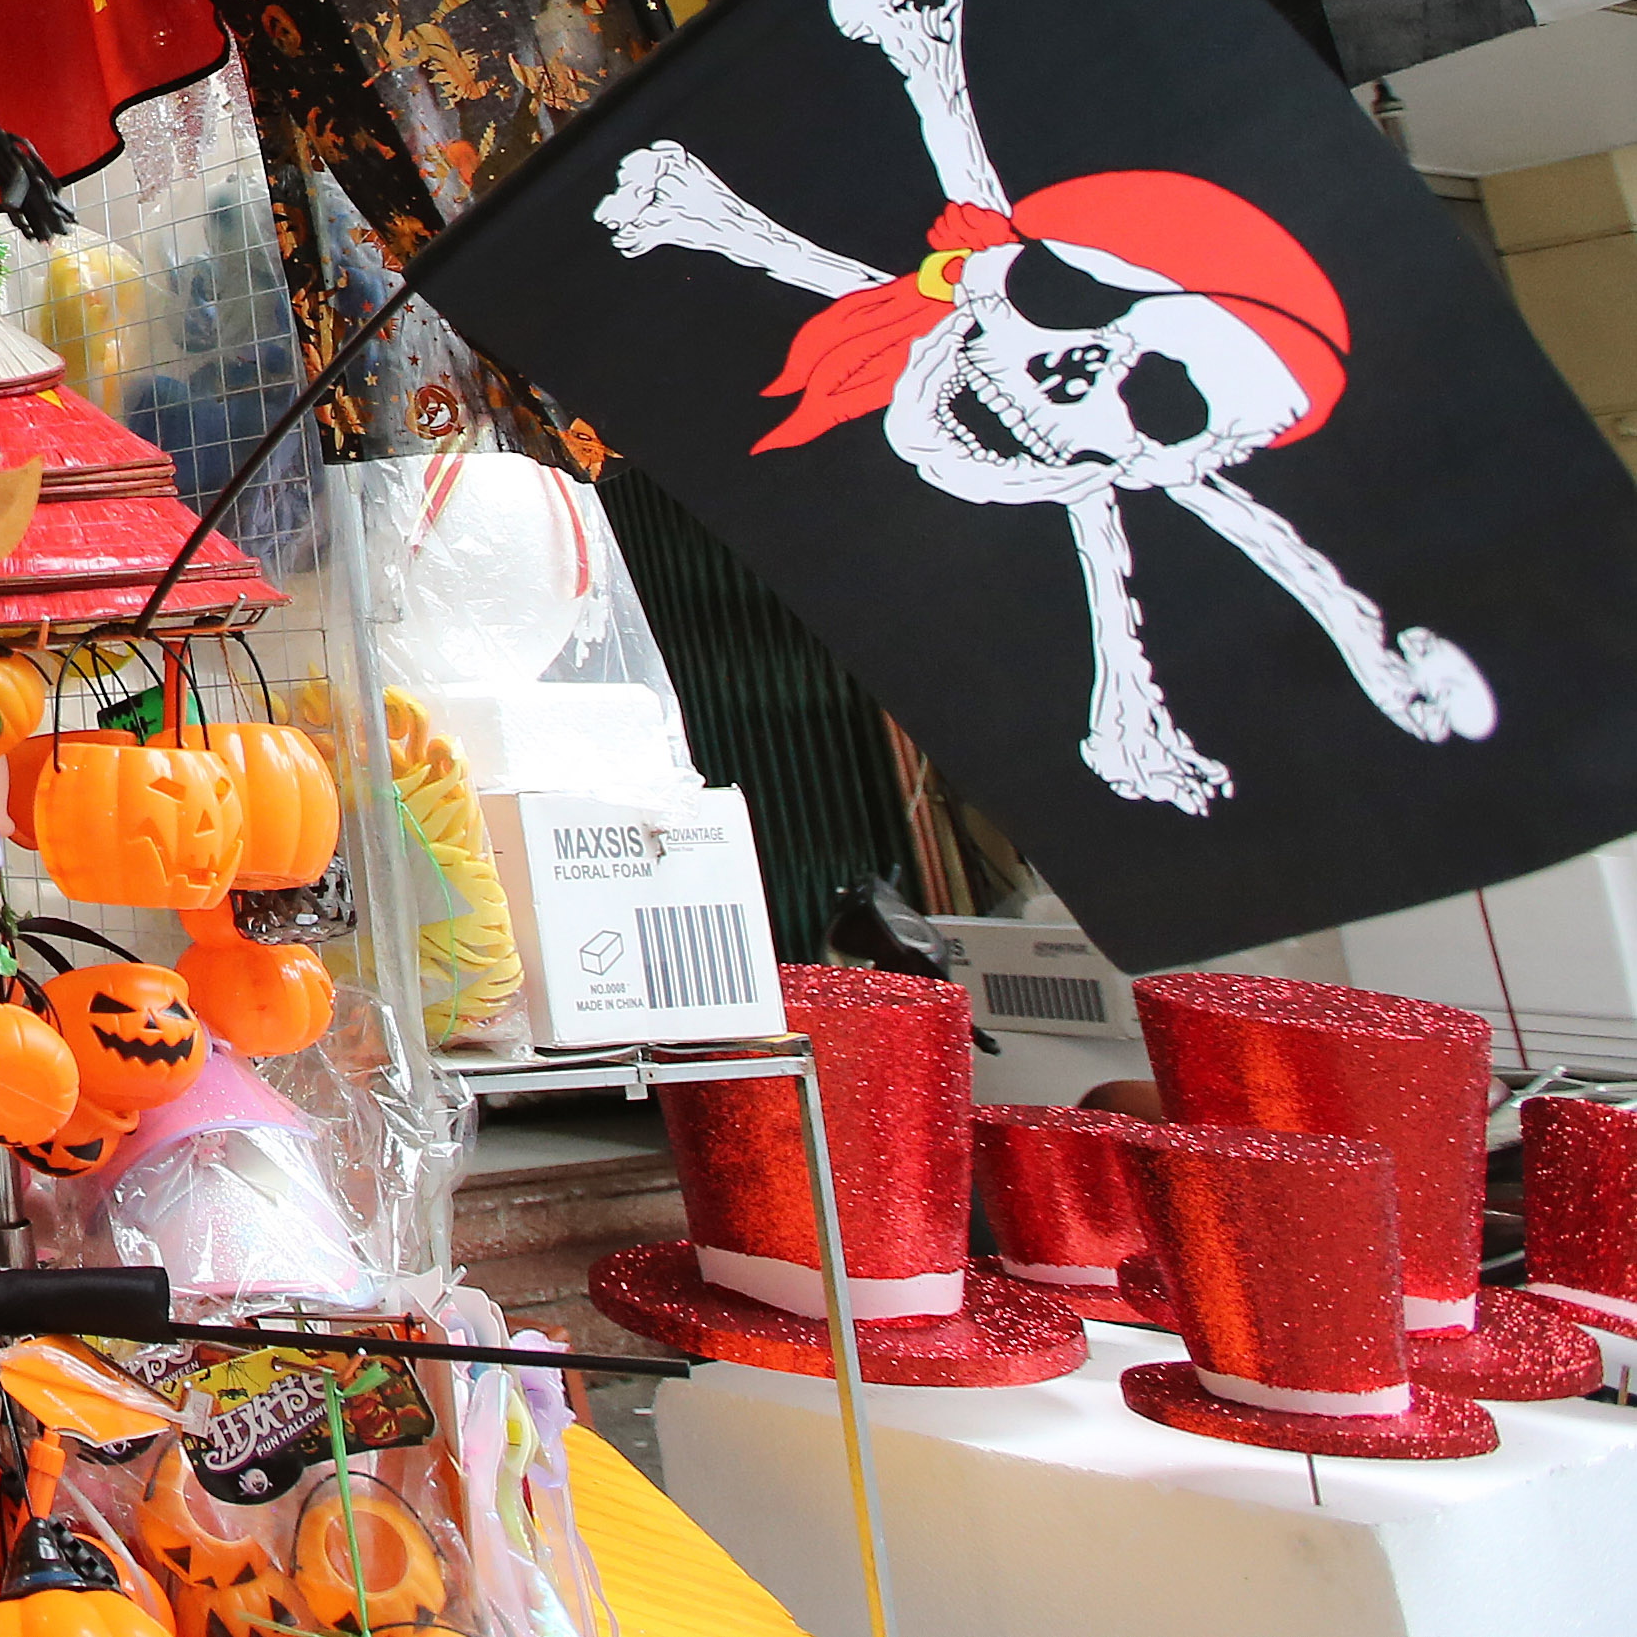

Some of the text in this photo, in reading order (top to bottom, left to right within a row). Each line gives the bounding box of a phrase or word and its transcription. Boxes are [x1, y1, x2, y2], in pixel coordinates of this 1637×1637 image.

[552, 825, 725, 860] MAXSIS ADVANTAGE
[553, 862, 654, 881] FLORAL FOAM
[575, 999, 645, 1012] MADE IN CHINA
[255, 1398, 347, 1458] FUN HALLOW
